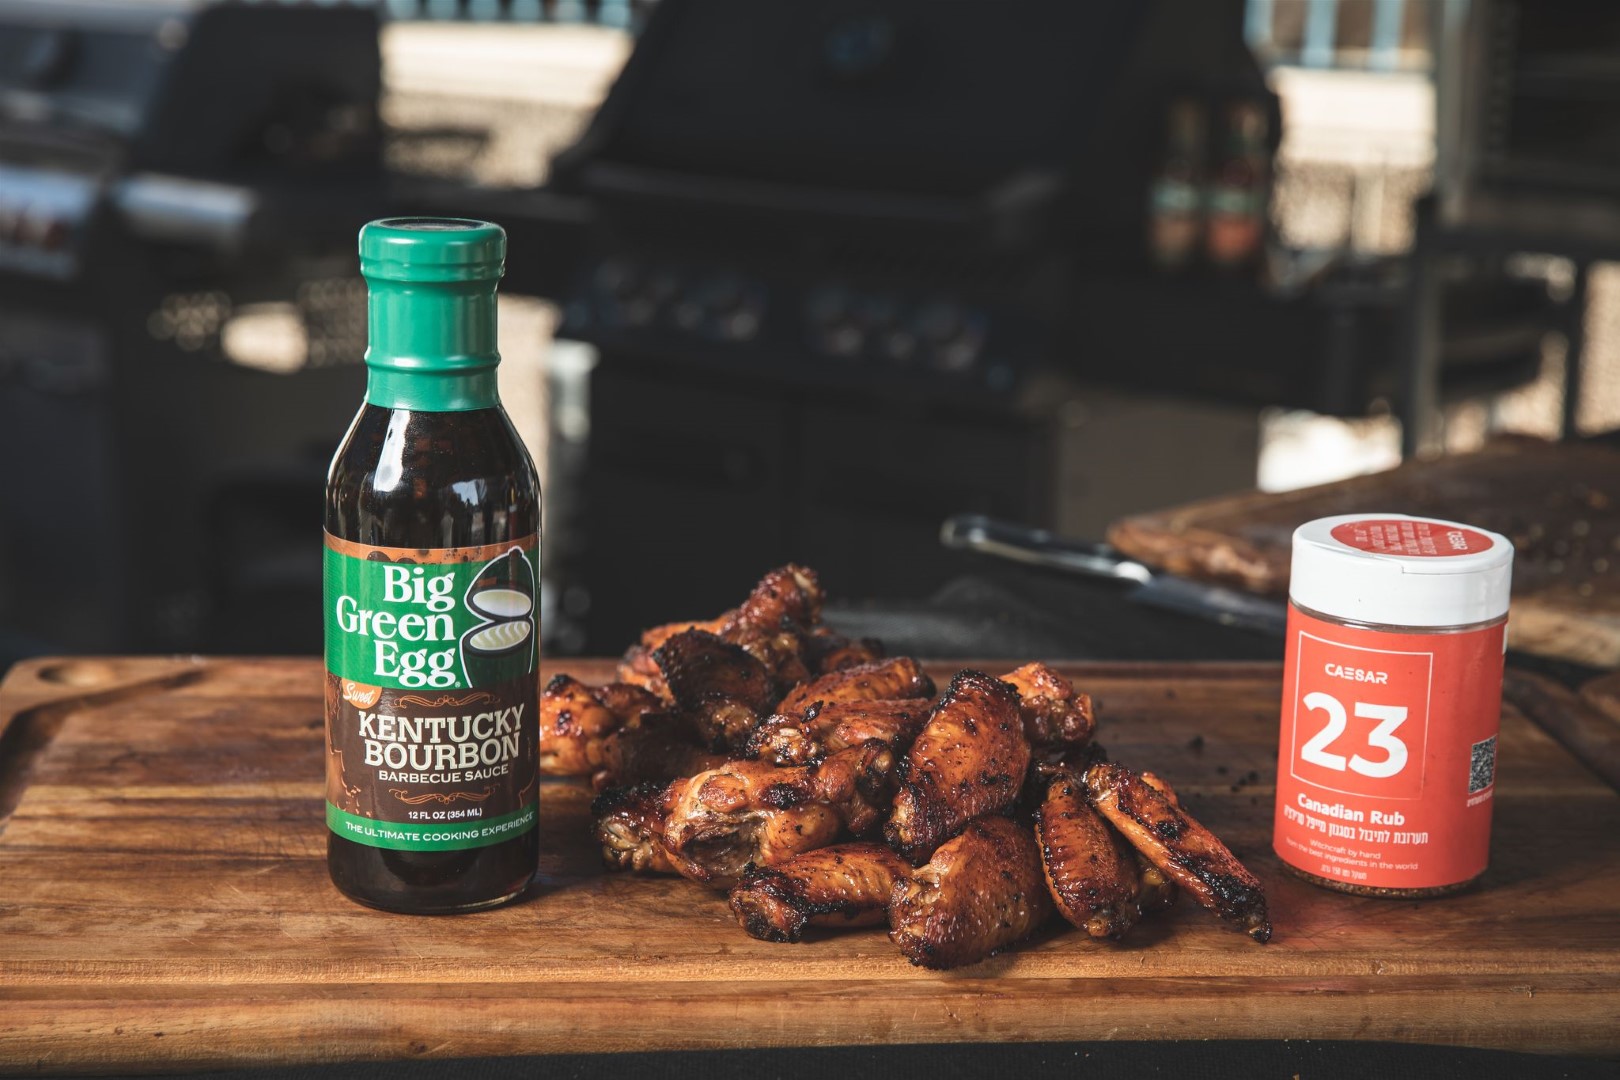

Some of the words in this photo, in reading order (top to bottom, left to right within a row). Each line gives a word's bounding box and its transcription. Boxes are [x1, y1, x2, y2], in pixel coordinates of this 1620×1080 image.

[383, 565, 455, 612] Big
[336, 595, 456, 641] Green
[1324, 663, 1388, 685] CAESAR
[343, 682, 375, 704] Sweet
[358, 702, 525, 743] KENTUCKY
[1301, 691, 1408, 778] 23
[364, 731, 520, 771] BOURBON
[378, 770, 462, 784] BARBECUE
[464, 763, 509, 781] SAUCE
[408, 811, 418, 820] 12
[419, 812, 430, 820] FL
[432, 811, 446, 820] OZ
[447, 809, 465, 820] (354
[466, 807, 483, 818] ML)
[1297, 793, 1364, 822] Canadian
[1370, 810, 1405, 826] Rub
[345, 821, 363, 834] THE
[364, 827, 420, 841] ULTIMATE
[422, 829, 479, 842] COOKING
[481, 811, 534, 837] EXPERIENCE
[1358, 827, 1391, 843] לתיבול
[1393, 832, 1429, 845] תערובת
[1310, 839, 1346, 854] Witchcraft
[1347, 849, 1358, 858] by
[1359, 850, 1381, 859] hand
